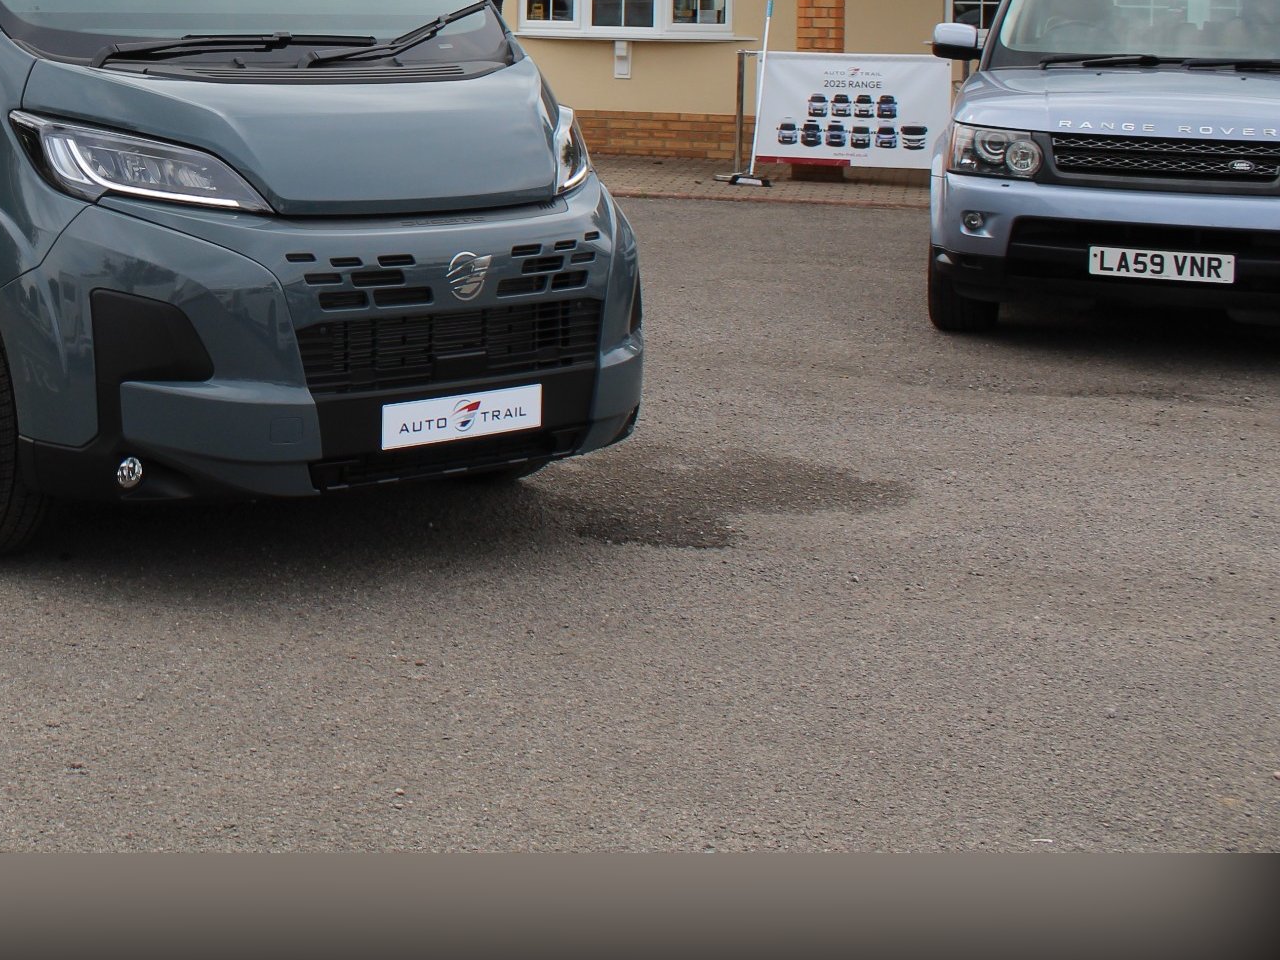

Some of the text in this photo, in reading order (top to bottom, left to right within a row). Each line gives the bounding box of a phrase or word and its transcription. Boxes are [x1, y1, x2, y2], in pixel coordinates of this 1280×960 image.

[824, 80, 882, 89] 2025 RANGE
[1058, 120, 1277, 137] RANGE ROVER
[1099, 251, 1222, 278] LA59 VNR
[399, 406, 527, 435] AUTO TRAIL
